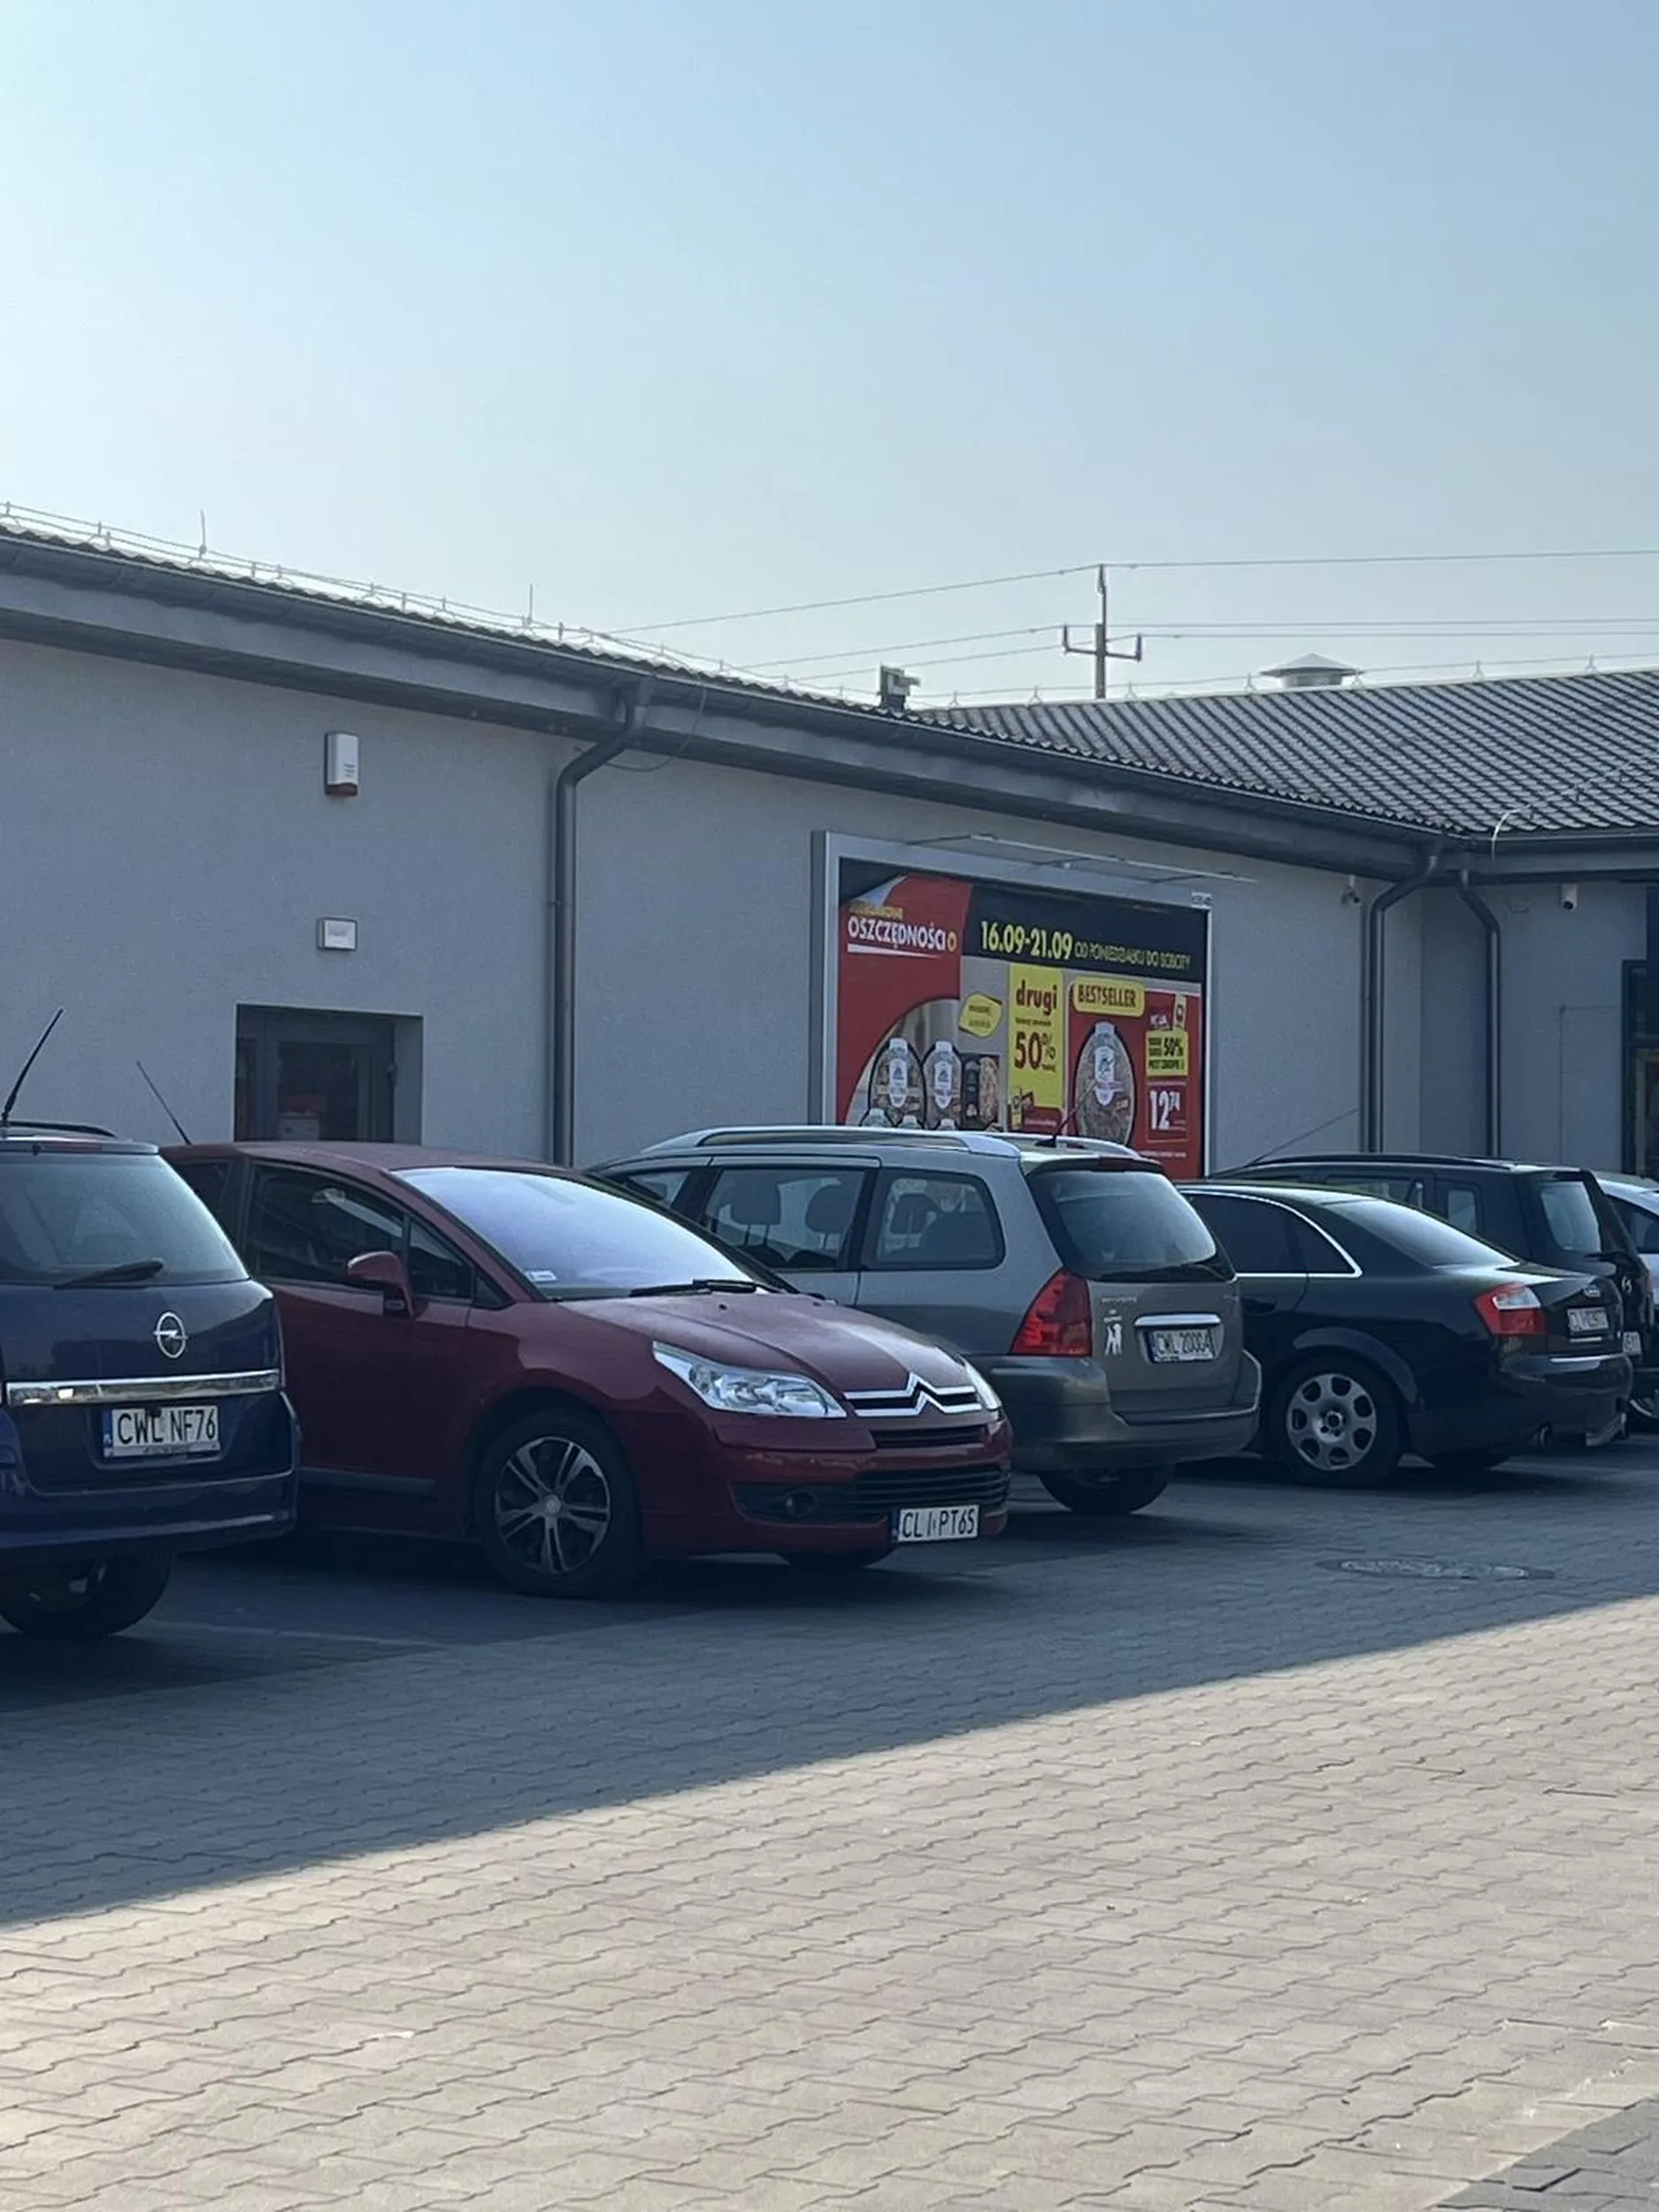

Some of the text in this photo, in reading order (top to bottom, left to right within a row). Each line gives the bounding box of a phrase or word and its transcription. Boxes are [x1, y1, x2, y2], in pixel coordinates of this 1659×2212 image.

[981, 920, 1072, 959] 16.09-21.09
[1016, 979, 1057, 1016] drugi
[1078, 983, 1136, 1008] BESTSELLER
[1014, 1031, 1056, 1070] 50%
[117, 1409, 216, 1444] CWL NF76
